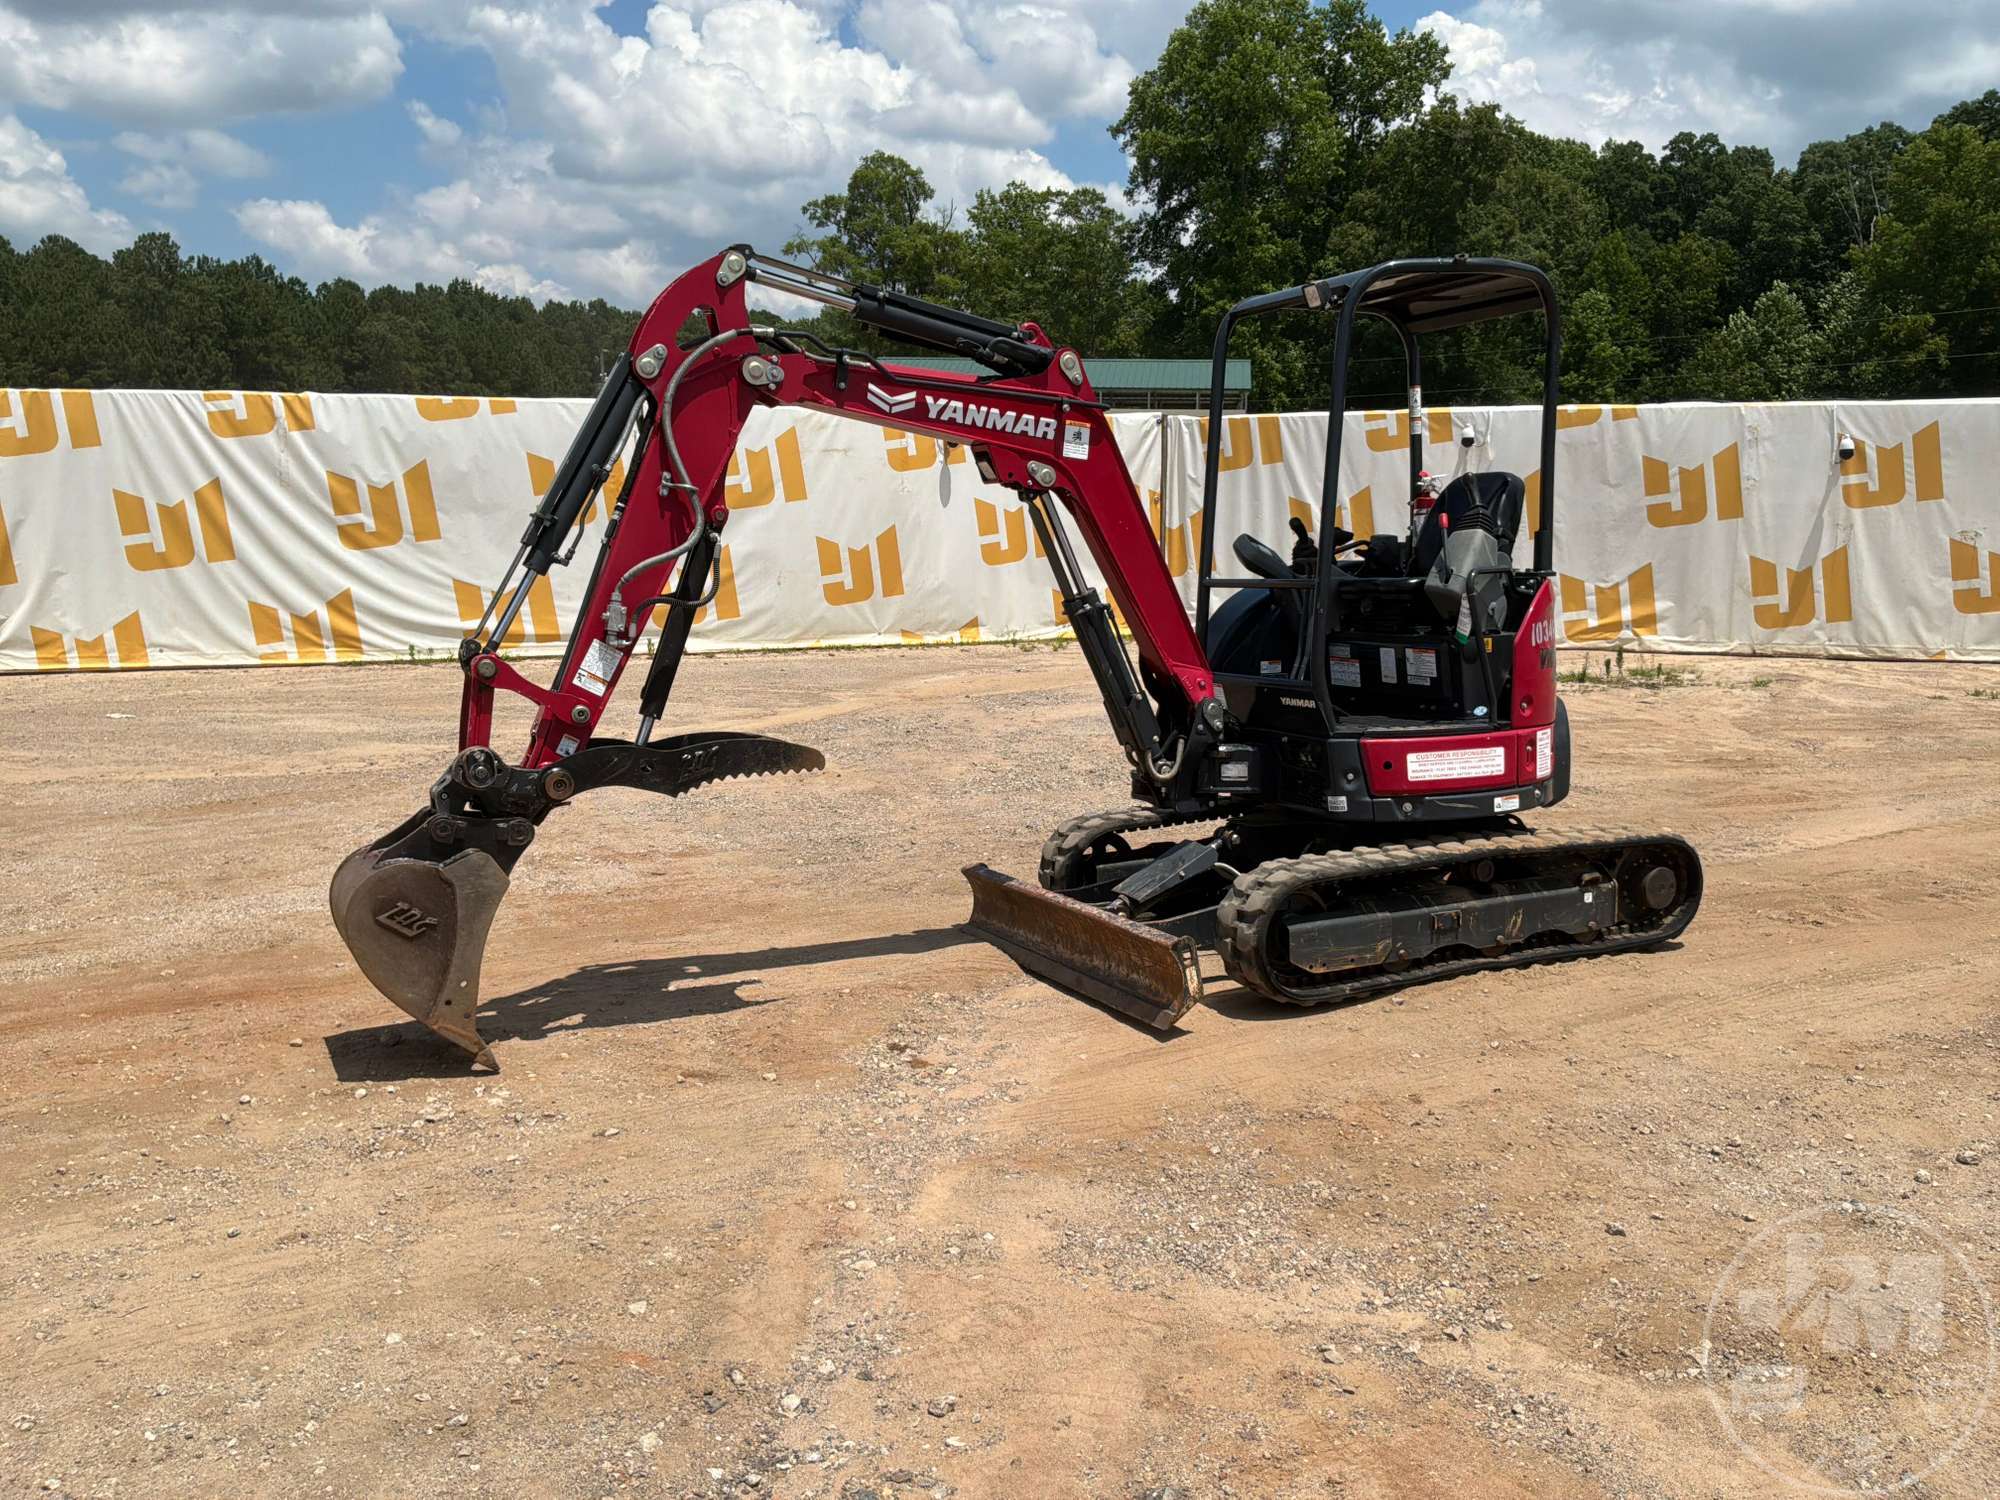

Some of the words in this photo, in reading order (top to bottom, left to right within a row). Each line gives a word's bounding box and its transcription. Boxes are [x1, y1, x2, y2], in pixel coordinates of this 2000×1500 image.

[924, 394, 1058, 440] YANMAR
[1279, 696, 1317, 709] YANMAR
[1415, 752, 1451, 761] CUSTOMER
